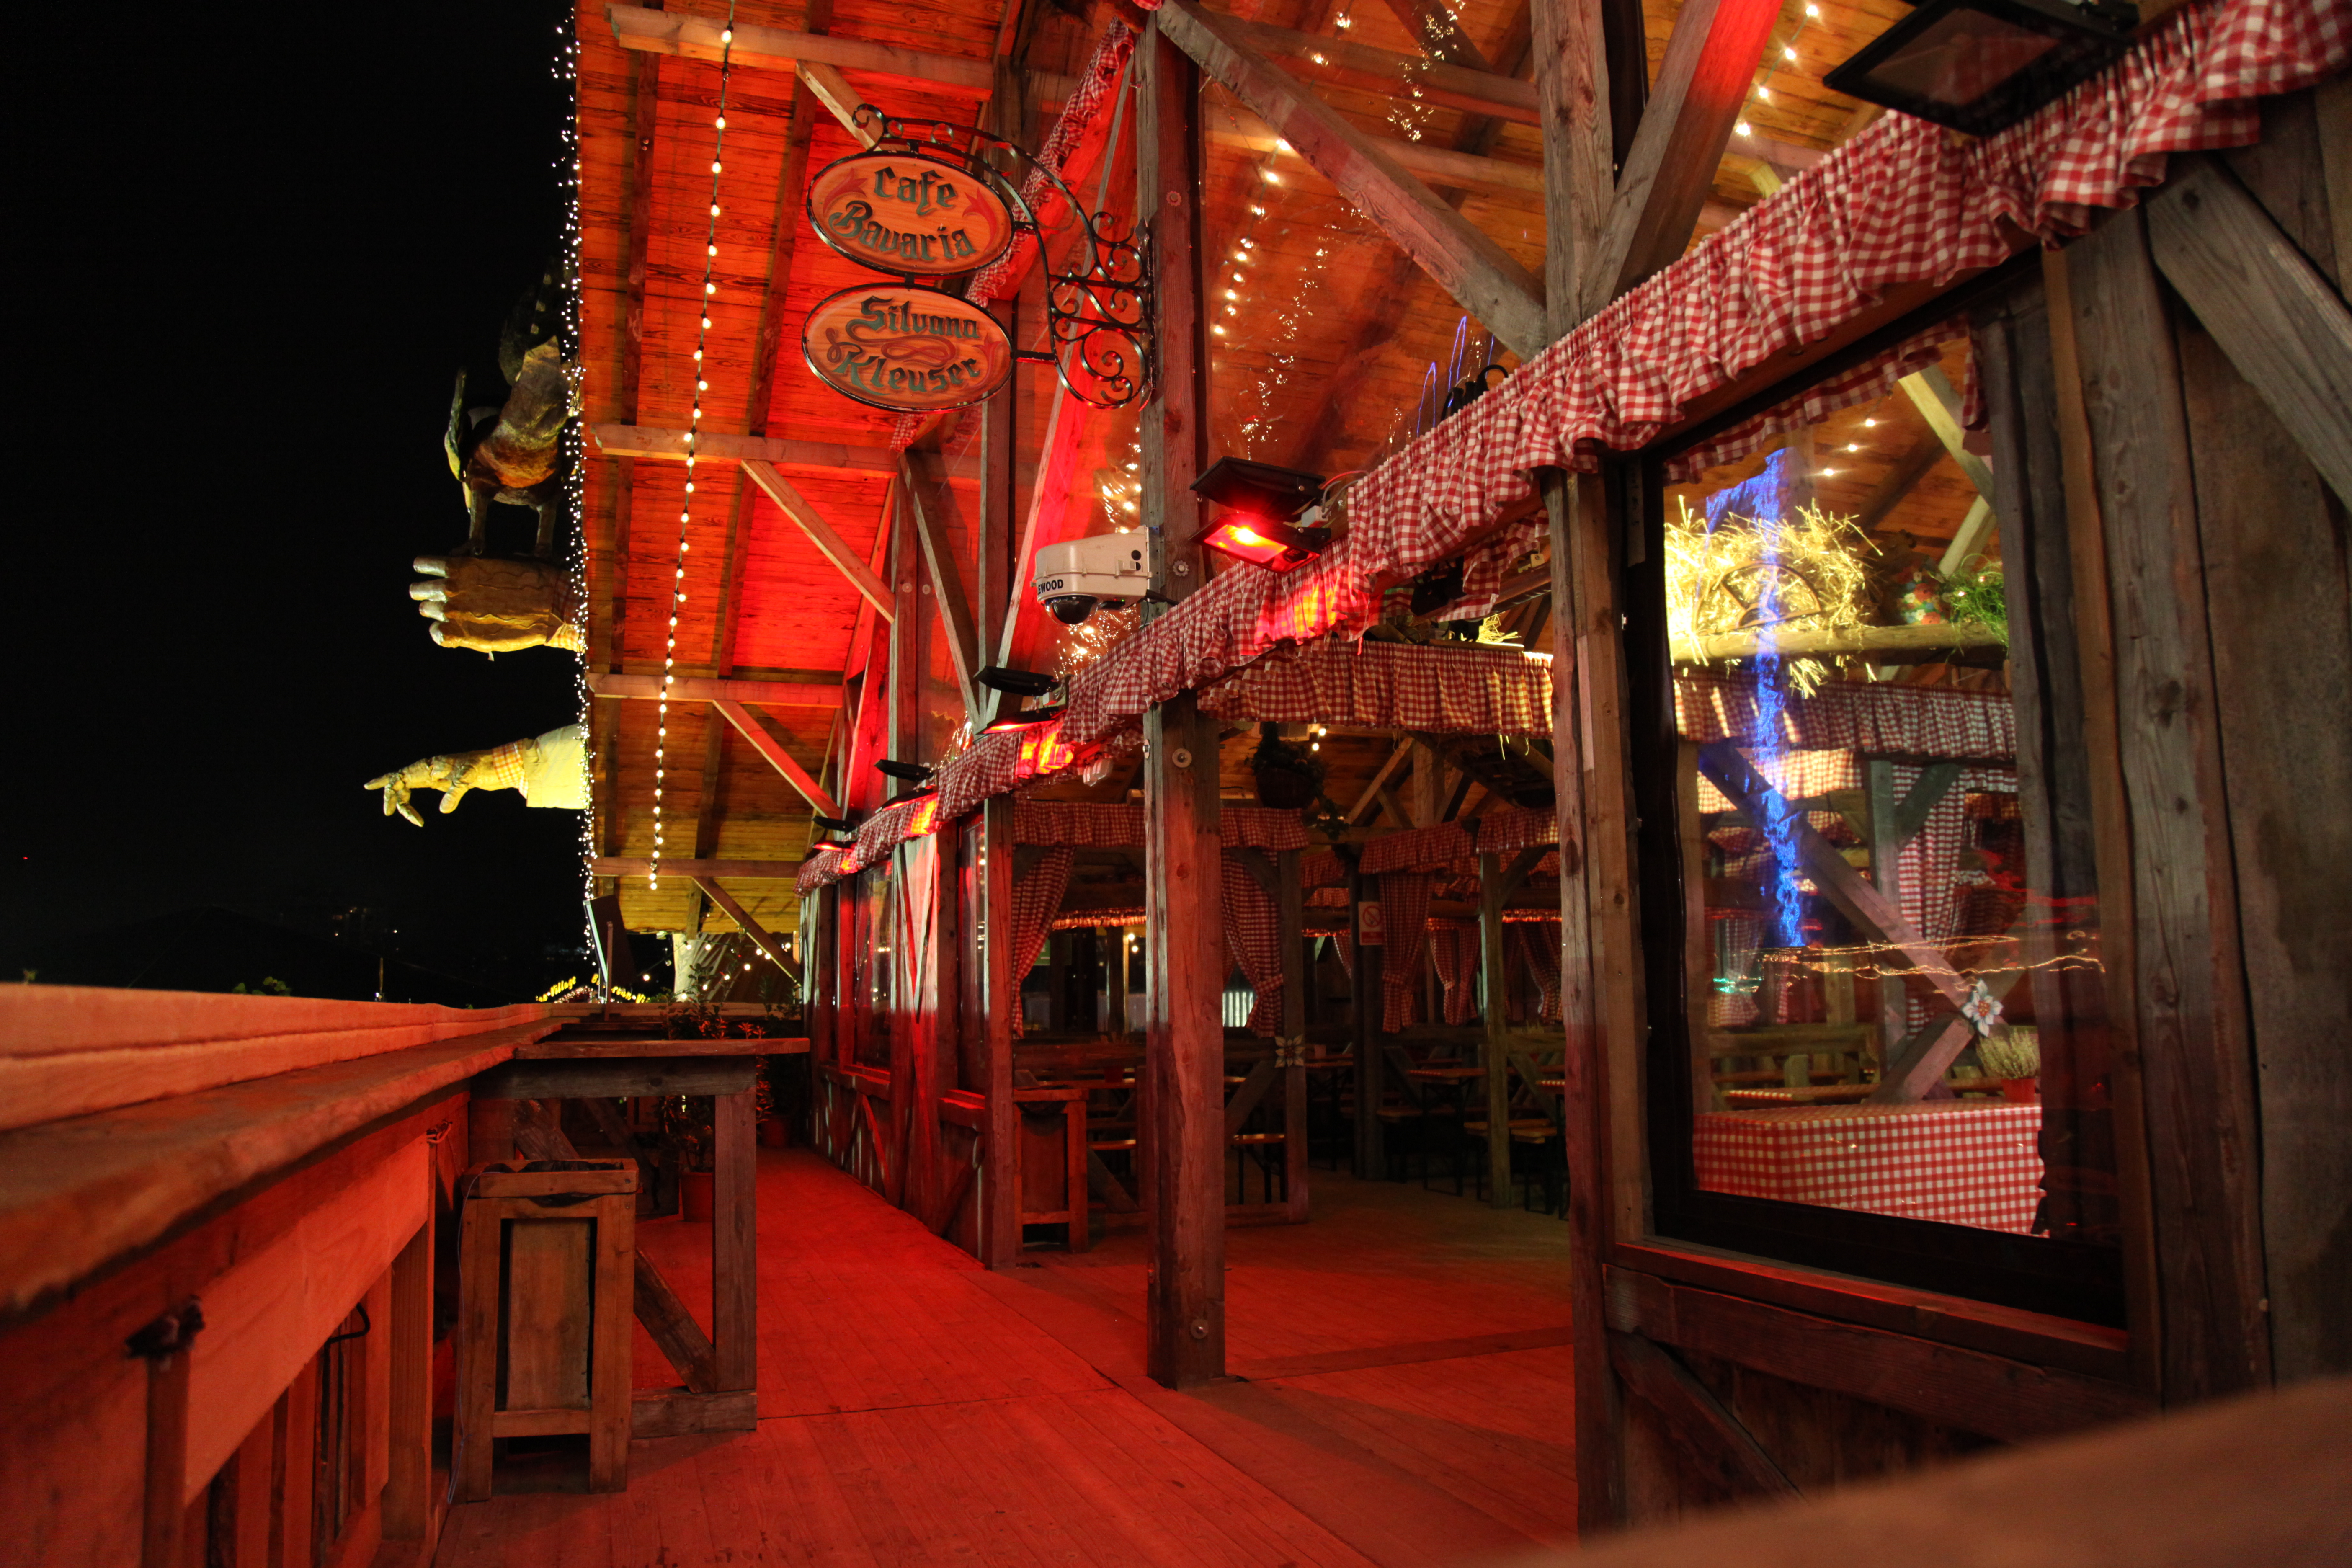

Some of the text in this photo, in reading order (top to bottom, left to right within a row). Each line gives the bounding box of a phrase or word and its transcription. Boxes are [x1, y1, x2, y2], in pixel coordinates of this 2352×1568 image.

[874, 167, 956, 215] Cafe
[828, 200, 977, 261] Bavaria
[846, 295, 980, 343] Silvana
[833, 341, 980, 395] Kleuser
[1037, 579, 1063, 595] EWOOD
